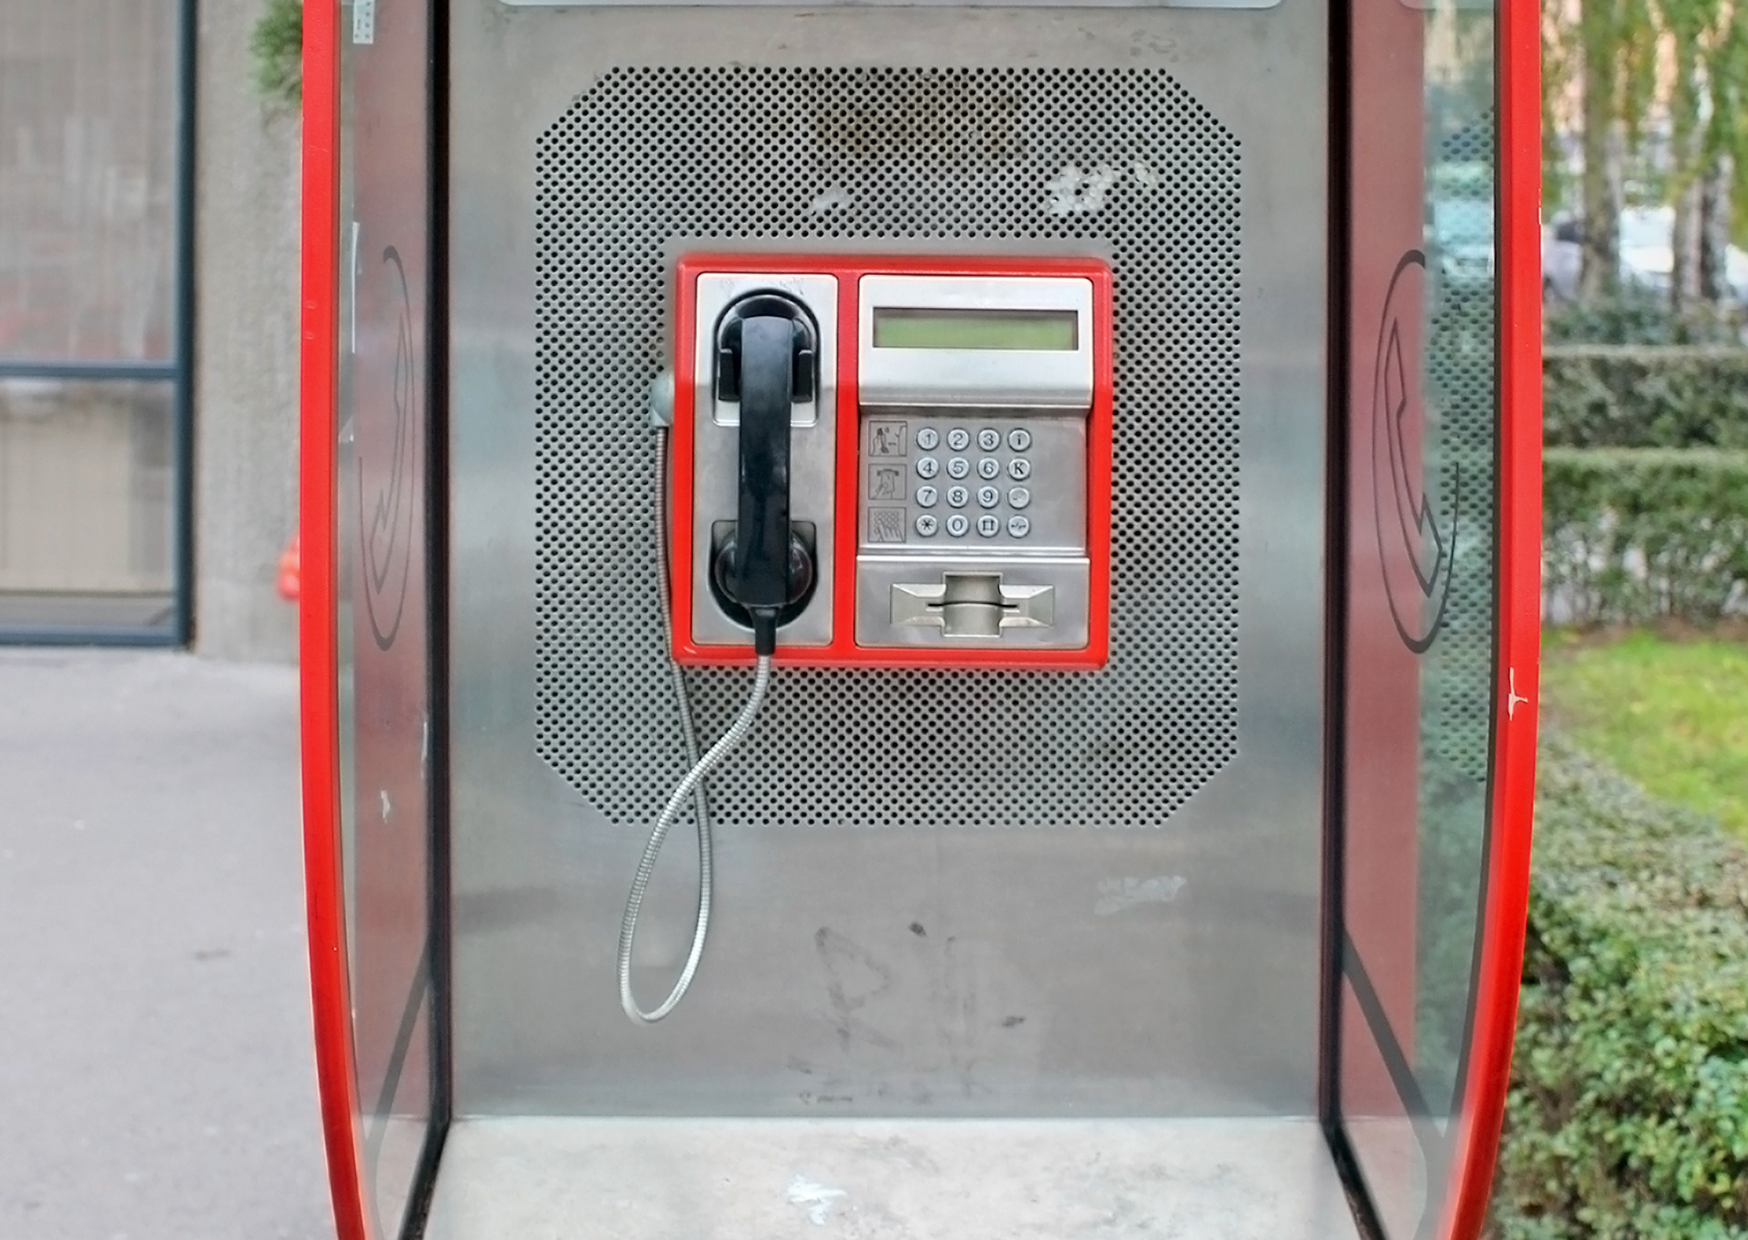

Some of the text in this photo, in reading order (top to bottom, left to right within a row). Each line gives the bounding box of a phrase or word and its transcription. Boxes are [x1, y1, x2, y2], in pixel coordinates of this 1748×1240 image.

[952, 432, 964, 446] 2
[983, 432, 995, 447] 3
[922, 461, 934, 474] 4
[952, 460, 964, 475] 5
[983, 461, 994, 475] 6
[922, 489, 993, 503] 7 8 9
[952, 518, 963, 532] 0
